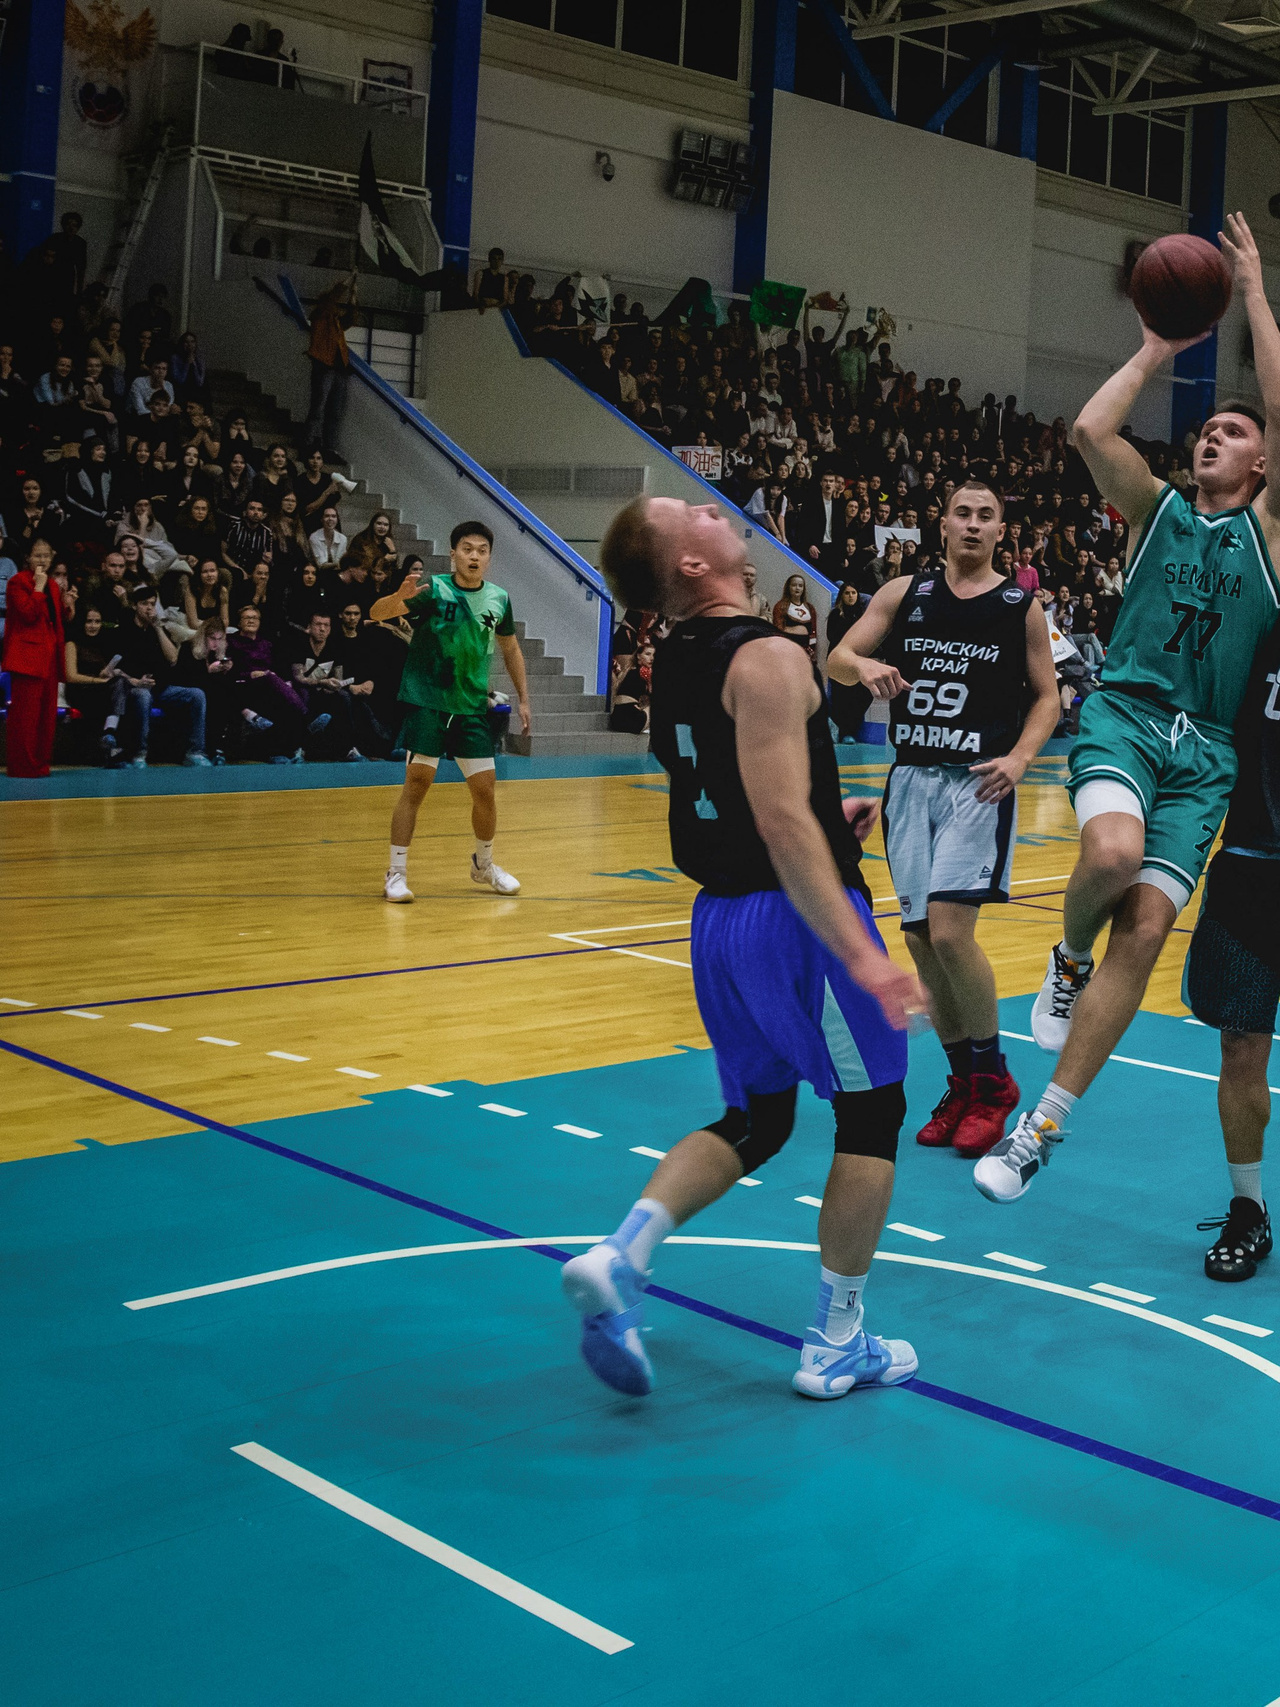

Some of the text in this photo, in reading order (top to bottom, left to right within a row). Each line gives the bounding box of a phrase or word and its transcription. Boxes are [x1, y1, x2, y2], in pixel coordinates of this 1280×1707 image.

[1161, 600, 1224, 663] 77
[904, 637, 1000, 663] ПЕРМСКИЙ
[920, 657, 970, 675] КРАЙ
[906, 679, 970, 719] 69
[895, 723, 982, 754] PARMA
